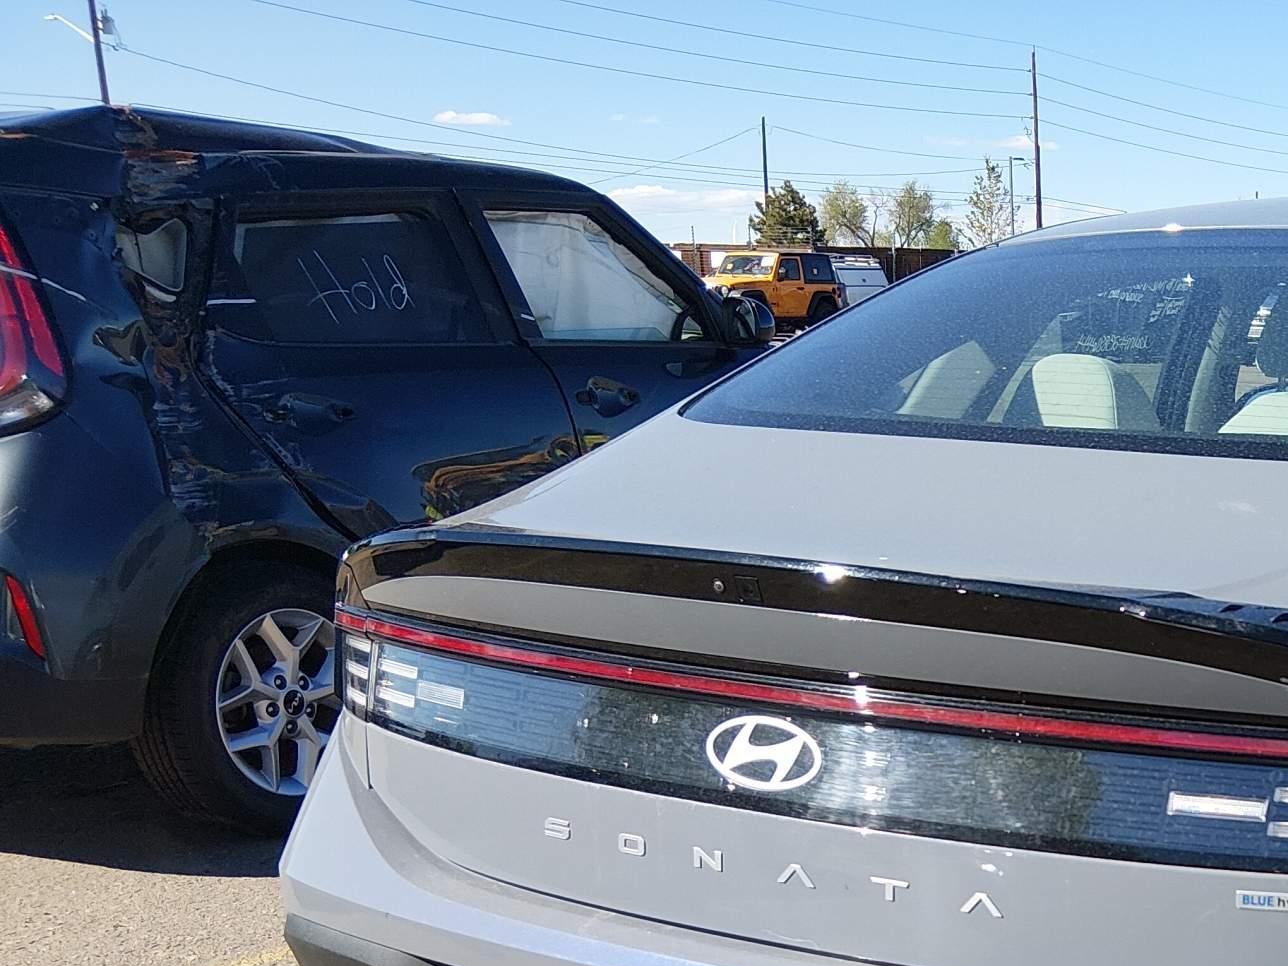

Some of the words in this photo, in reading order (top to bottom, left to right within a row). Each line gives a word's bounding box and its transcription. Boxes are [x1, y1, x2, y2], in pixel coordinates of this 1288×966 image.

[297, 250, 416, 324] Hold
[543, 816, 1004, 919] SONATA
[1242, 894, 1274, 907] BLUE
